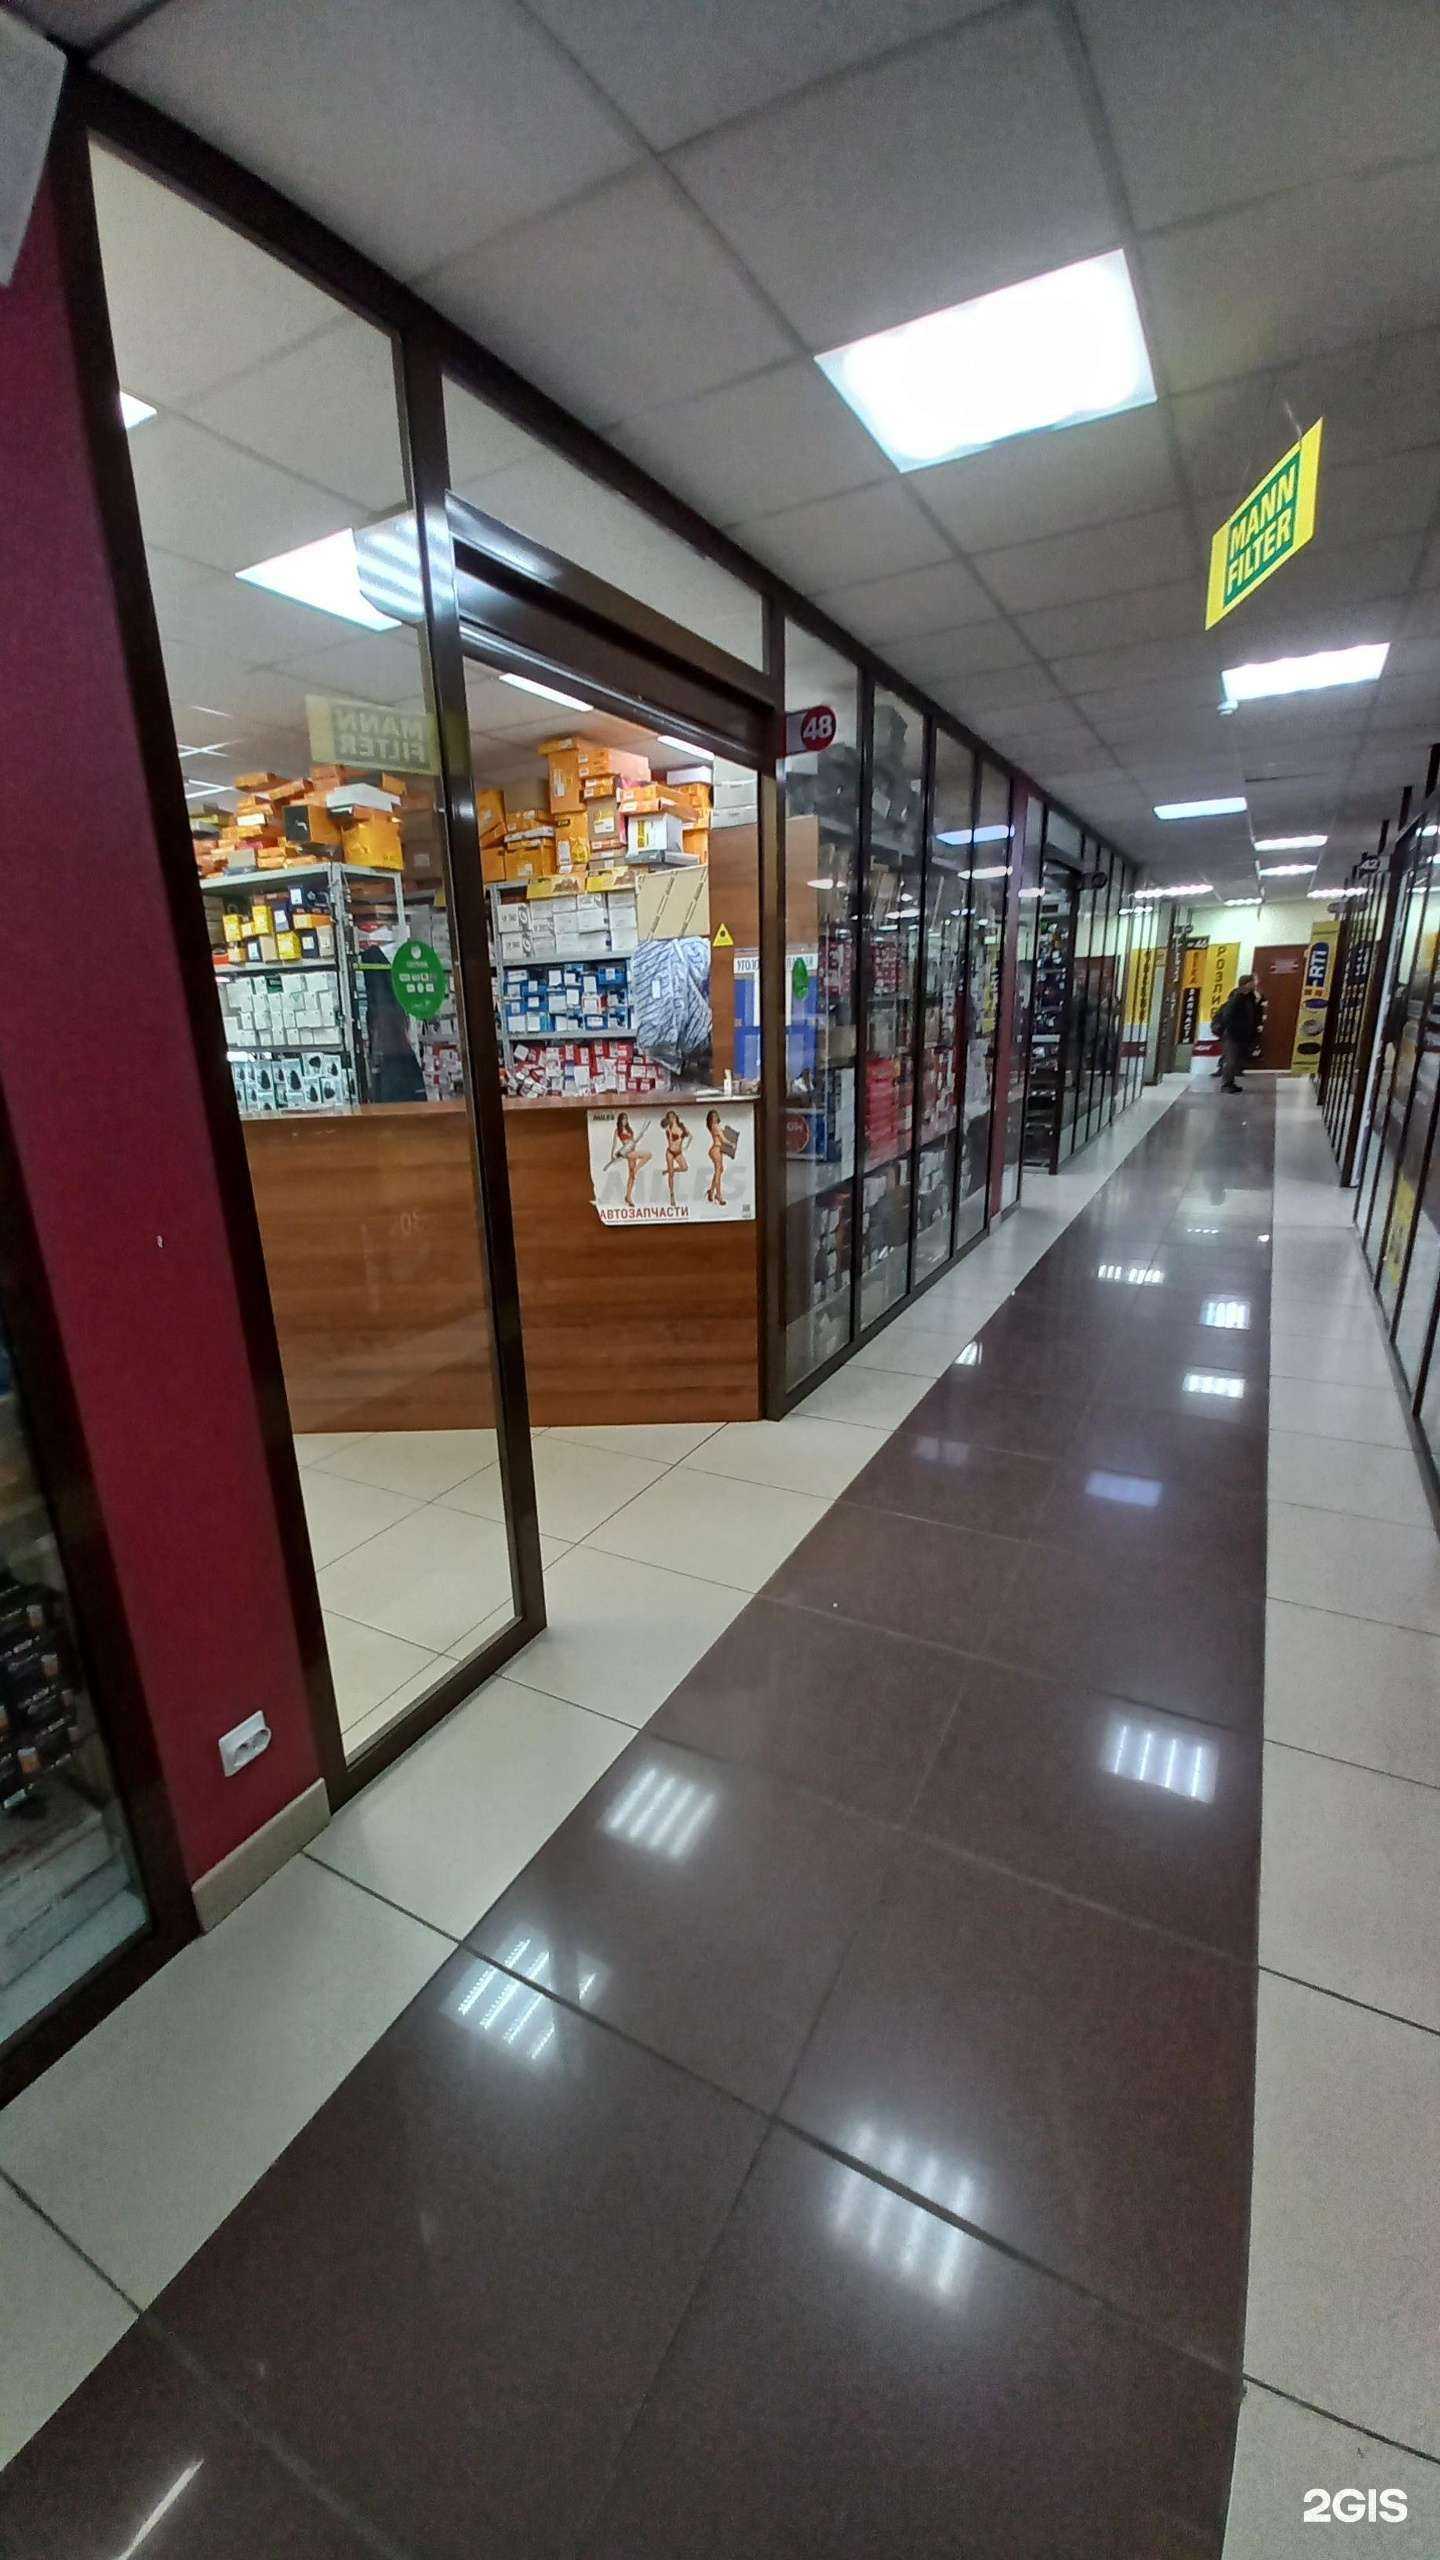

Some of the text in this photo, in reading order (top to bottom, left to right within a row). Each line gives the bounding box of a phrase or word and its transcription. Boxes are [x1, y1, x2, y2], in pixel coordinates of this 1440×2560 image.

[1229, 464, 1296, 560] MANN
[1226, 508, 1293, 597] FILTER
[802, 714, 834, 741] 48
[737, 959, 760, 971] УГОЛО
[600, 1206, 689, 1220] АВТОЗАПЧАСТИ
